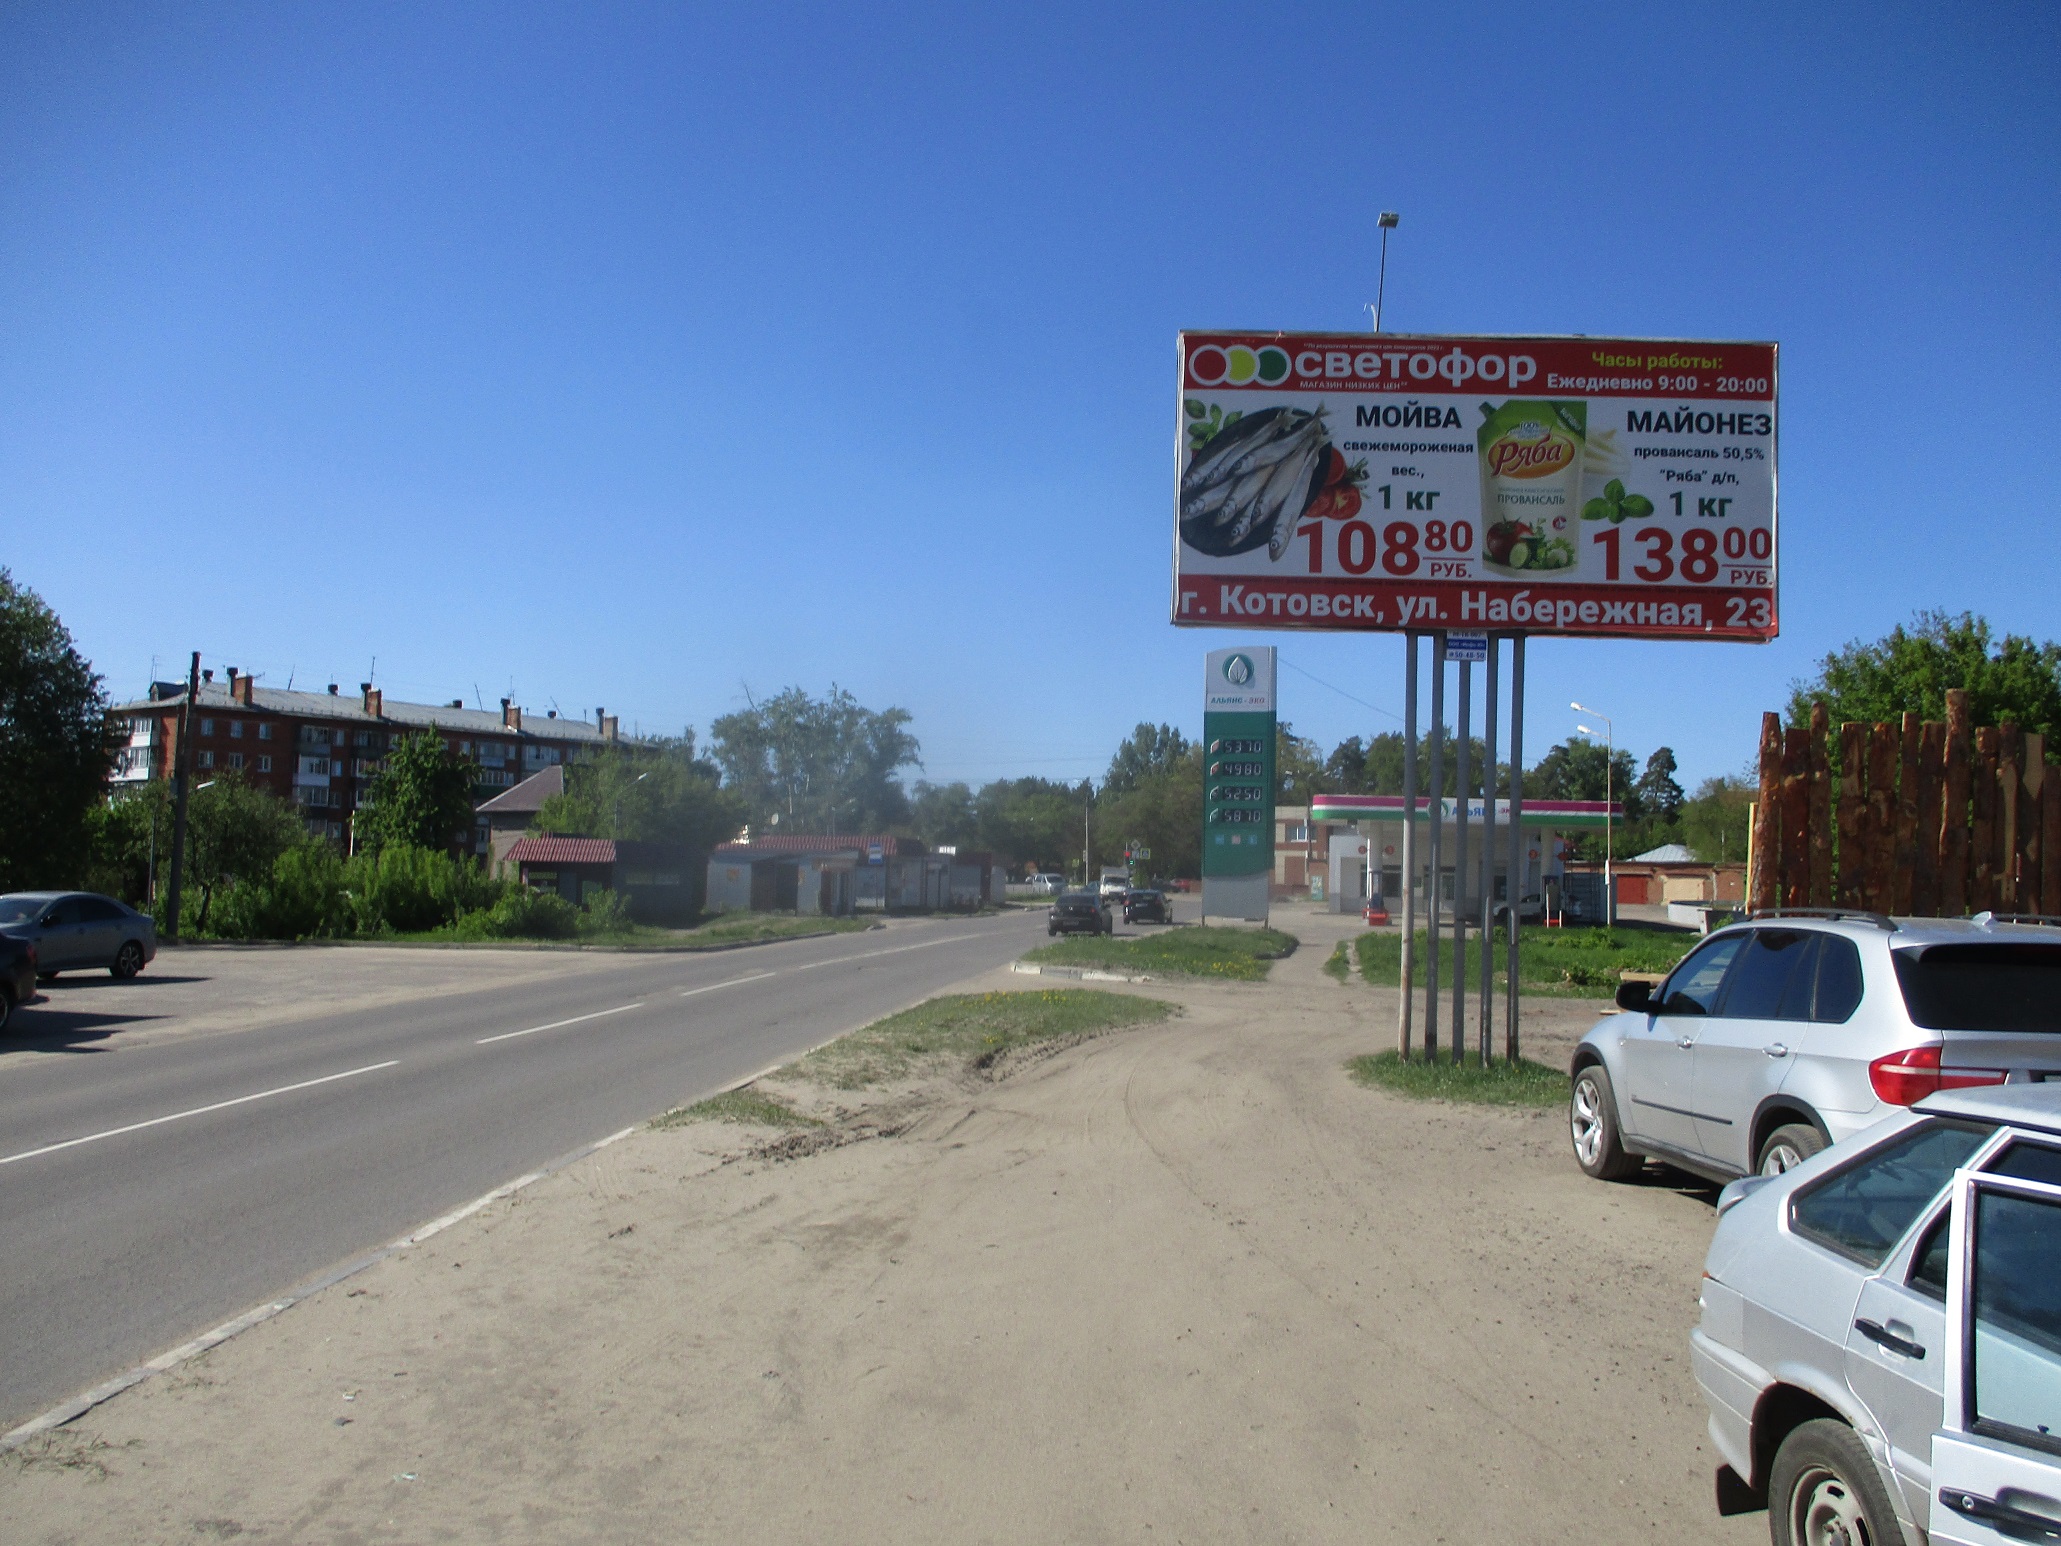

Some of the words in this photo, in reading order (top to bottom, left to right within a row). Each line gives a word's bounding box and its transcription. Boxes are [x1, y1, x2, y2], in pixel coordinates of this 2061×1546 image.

[1295, 347, 1537, 389] светофор
[1592, 352, 1642, 367] Часы
[1647, 353, 1723, 371] работы:
[1300, 380, 1342, 389] МАГАЗИН
[1345, 381, 1380, 390] НИЗКИХ
[1547, 373, 1653, 391] Ежедневно
[1658, 375, 1697, 391] 9:00
[1716, 377, 1768, 393] 20:00
[1356, 400, 1462, 428] МОЙВА
[1627, 406, 1771, 436] МАЙОНЕЗ
[1343, 441, 1474, 455] свежемороженая
[1491, 433, 1563, 477] Ряба
[1634, 447, 1719, 460] провансаль
[1723, 447, 1765, 462] 50,5%
[1391, 466, 1425, 479] вес.,
[1711, 472, 1740, 486] д/п,
[1378, 484, 1391, 510] 1
[1406, 491, 1441, 511] кг
[1497, 494, 1566, 506] ПРОВАНСАЛЬ
[1669, 491, 1683, 516] 1
[1698, 498, 1733, 517] кг
[1296, 520, 1421, 577] 108
[1424, 520, 1474, 553] 80
[1593, 526, 1719, 584] 138
[1723, 526, 1772, 560] 00
[1430, 562, 1473, 579] РУБ.
[1730, 569, 1774, 586] РУБ.
[1181, 590, 1208, 615] г.
[1220, 584, 1384, 625] Котовск,
[1396, 595, 1449, 627] ул.
[1461, 590, 1714, 632] Набережная,
[1725, 597, 1772, 628] 23
